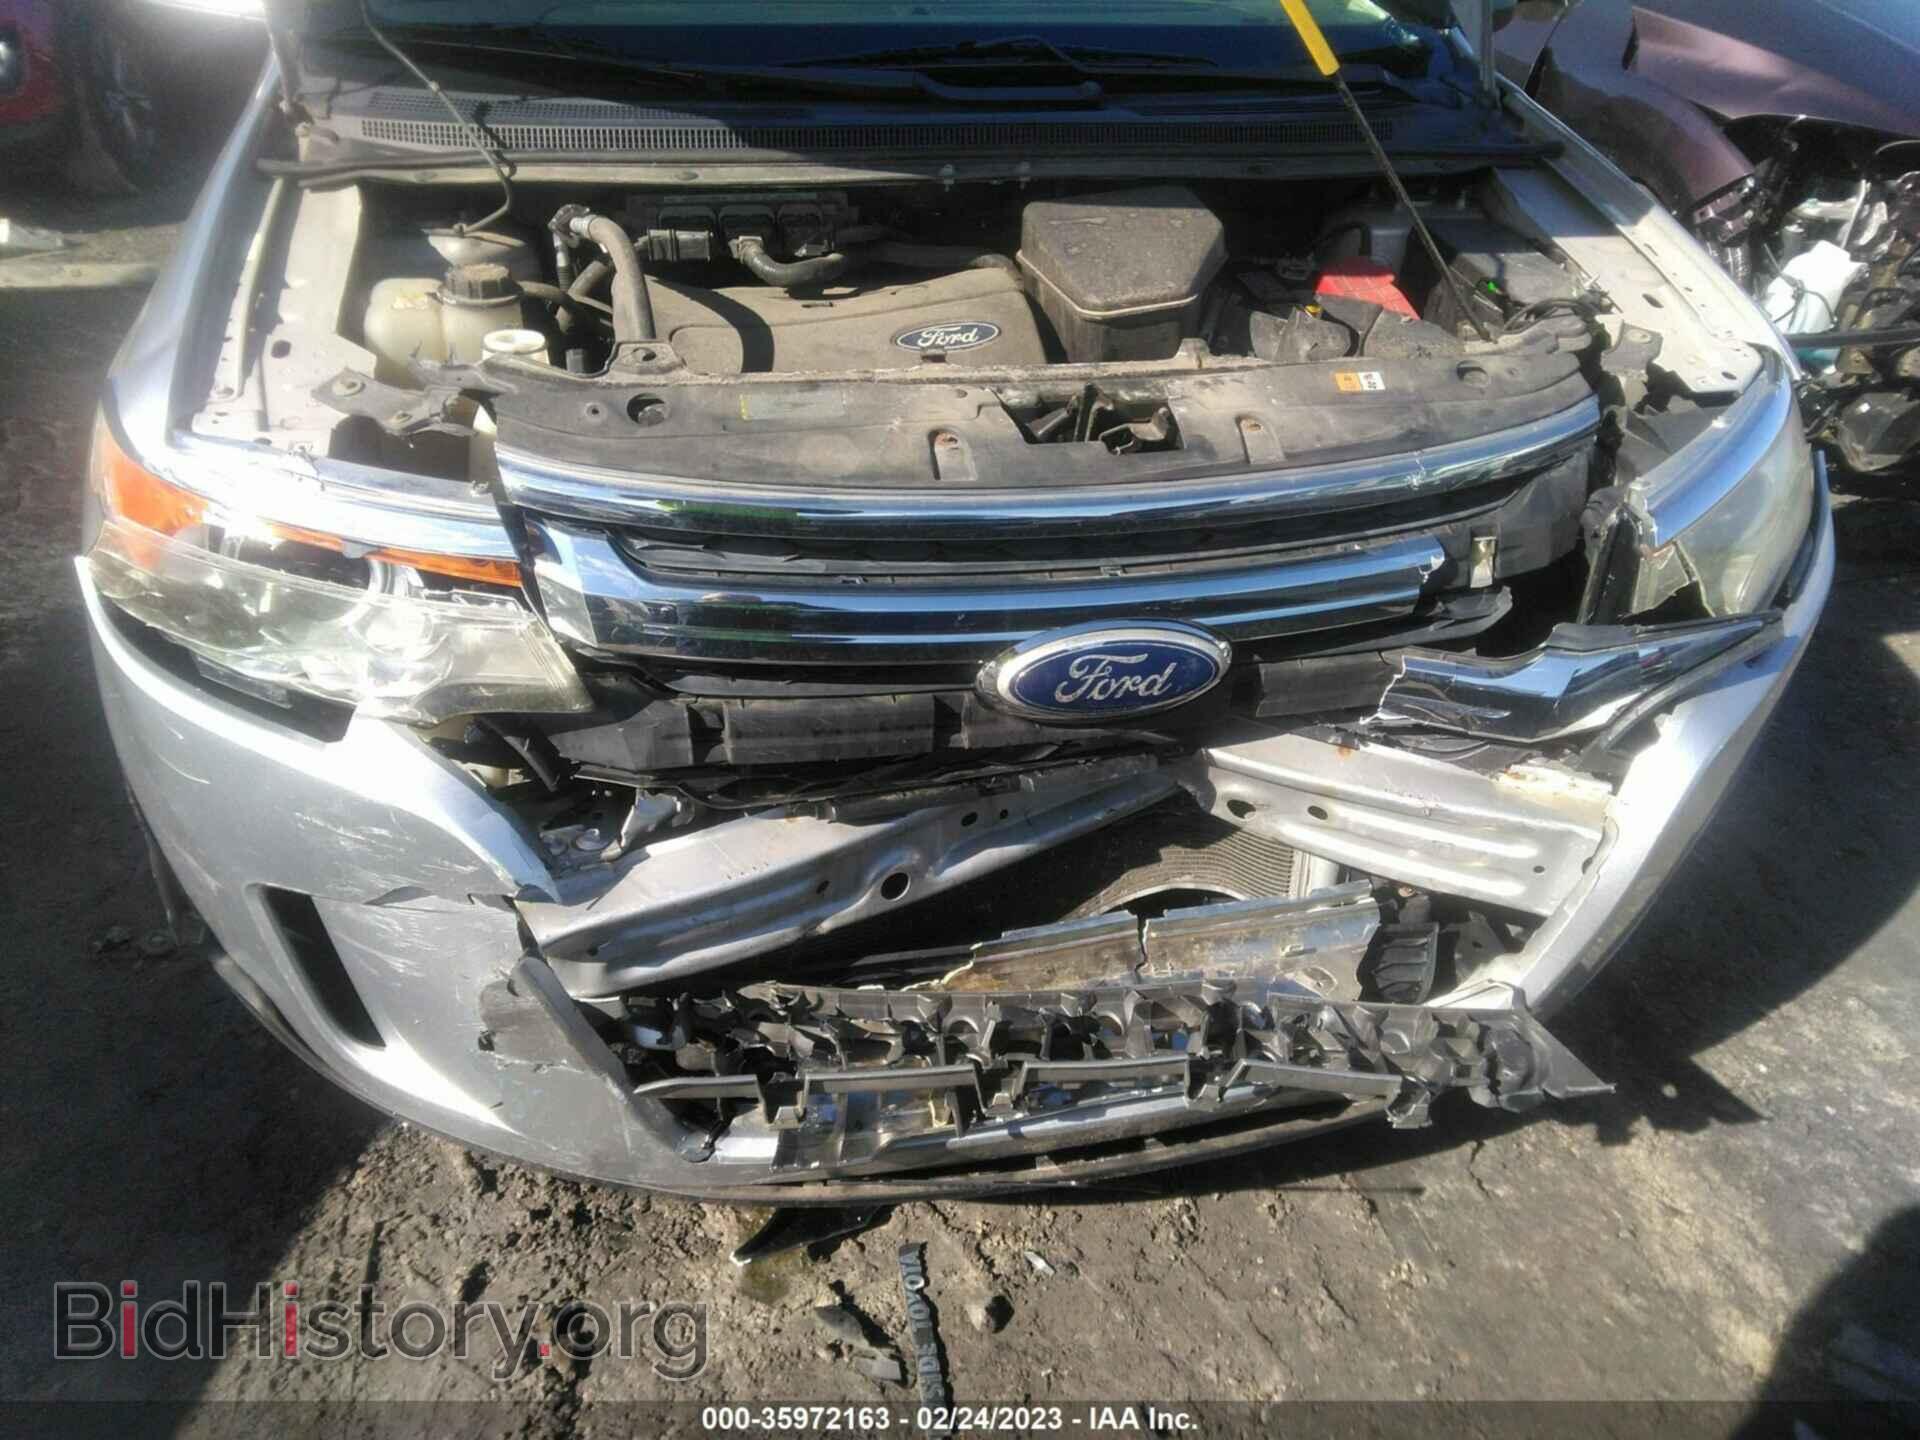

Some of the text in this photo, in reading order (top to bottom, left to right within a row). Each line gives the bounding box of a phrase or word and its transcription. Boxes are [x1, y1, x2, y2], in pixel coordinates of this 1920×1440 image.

[917, 327, 980, 347] Ford
[1055, 653, 1178, 704] Ford
[899, 1249, 931, 1333] TOYOTA
